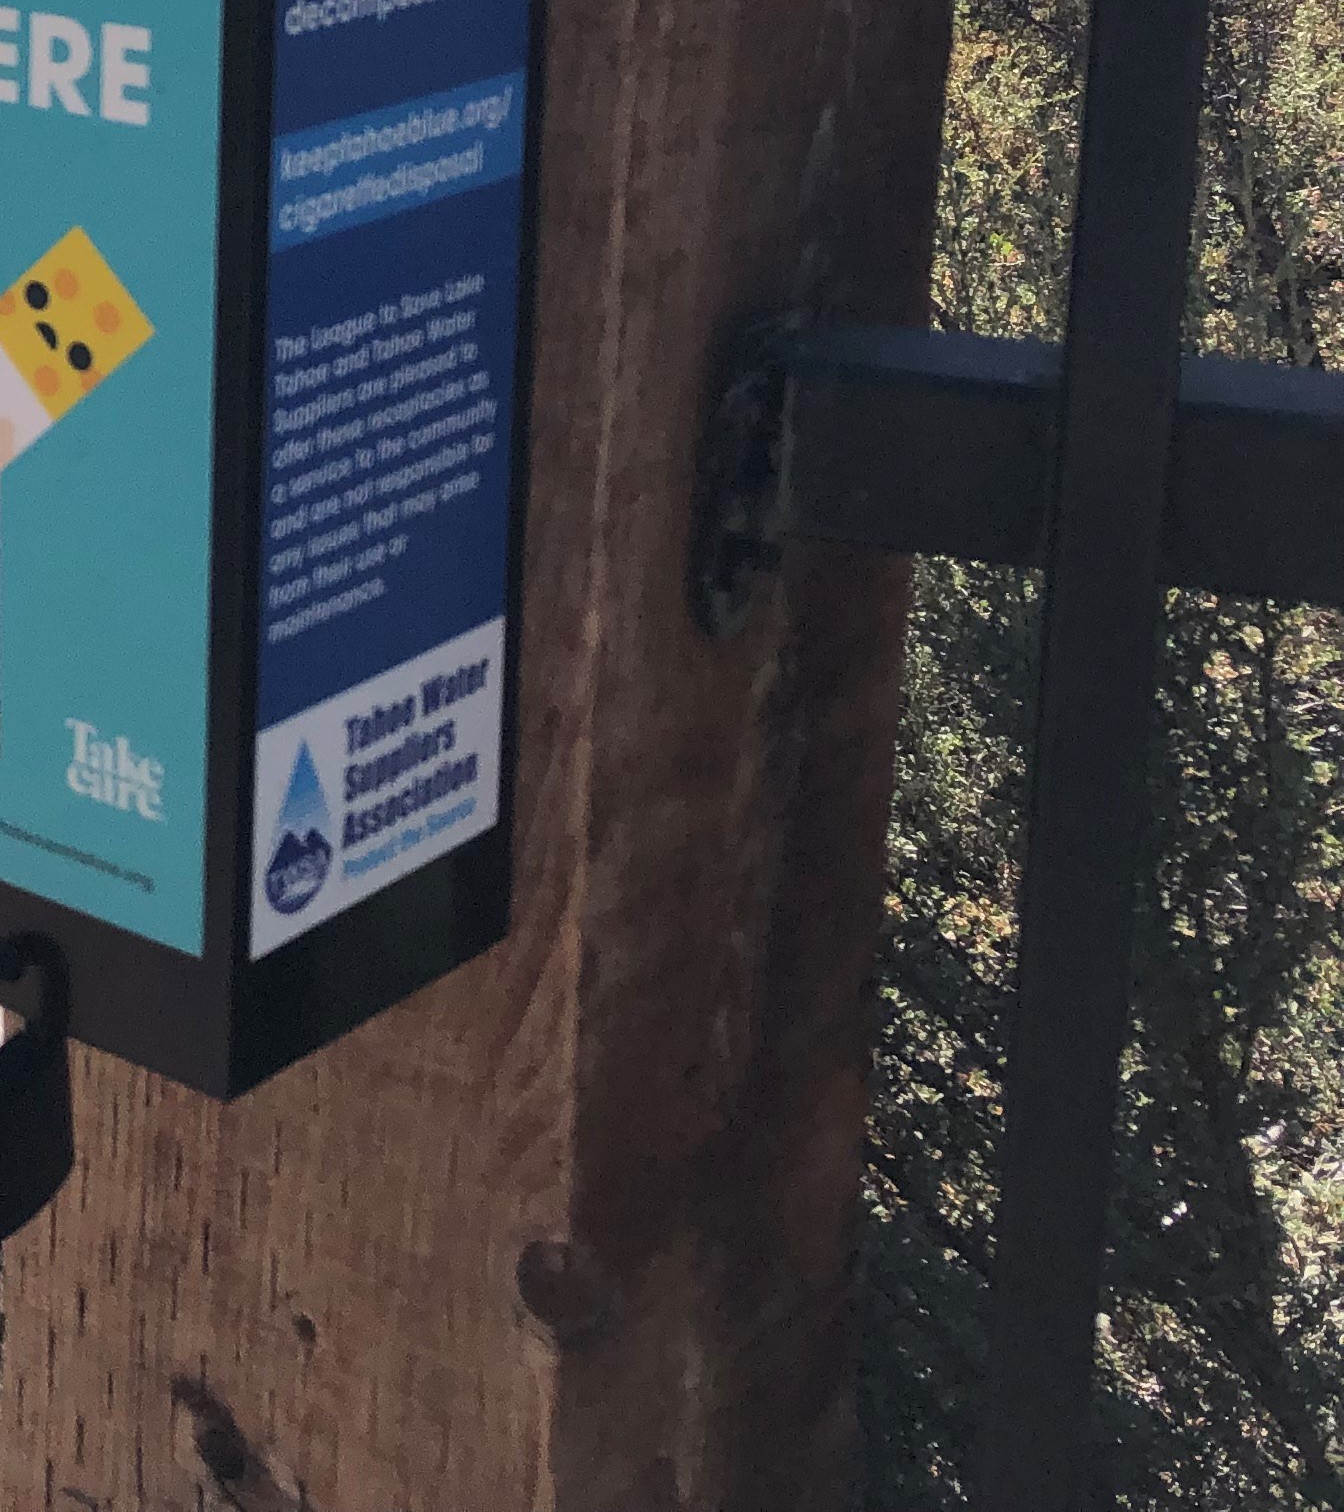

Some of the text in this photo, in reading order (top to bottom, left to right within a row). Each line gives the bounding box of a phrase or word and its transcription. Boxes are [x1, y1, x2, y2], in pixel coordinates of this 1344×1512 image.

[281, 85, 512, 181] keeptahoeblue.org/
[278, 140, 484, 233] cigarettedisposal
[274, 335, 308, 362] The
[311, 312, 378, 350] League
[400, 290, 443, 318] Save
[444, 273, 484, 303] Lake
[274, 310, 476, 398] Tahoe and Tahoe Water
[376, 435, 406, 460] the
[270, 504, 309, 539] and
[64, 716, 165, 784] Take
[344, 657, 490, 756] Tahoe Water
[67, 761, 164, 823] care
[341, 752, 479, 850] Association
[343, 719, 456, 803] Suppliers
